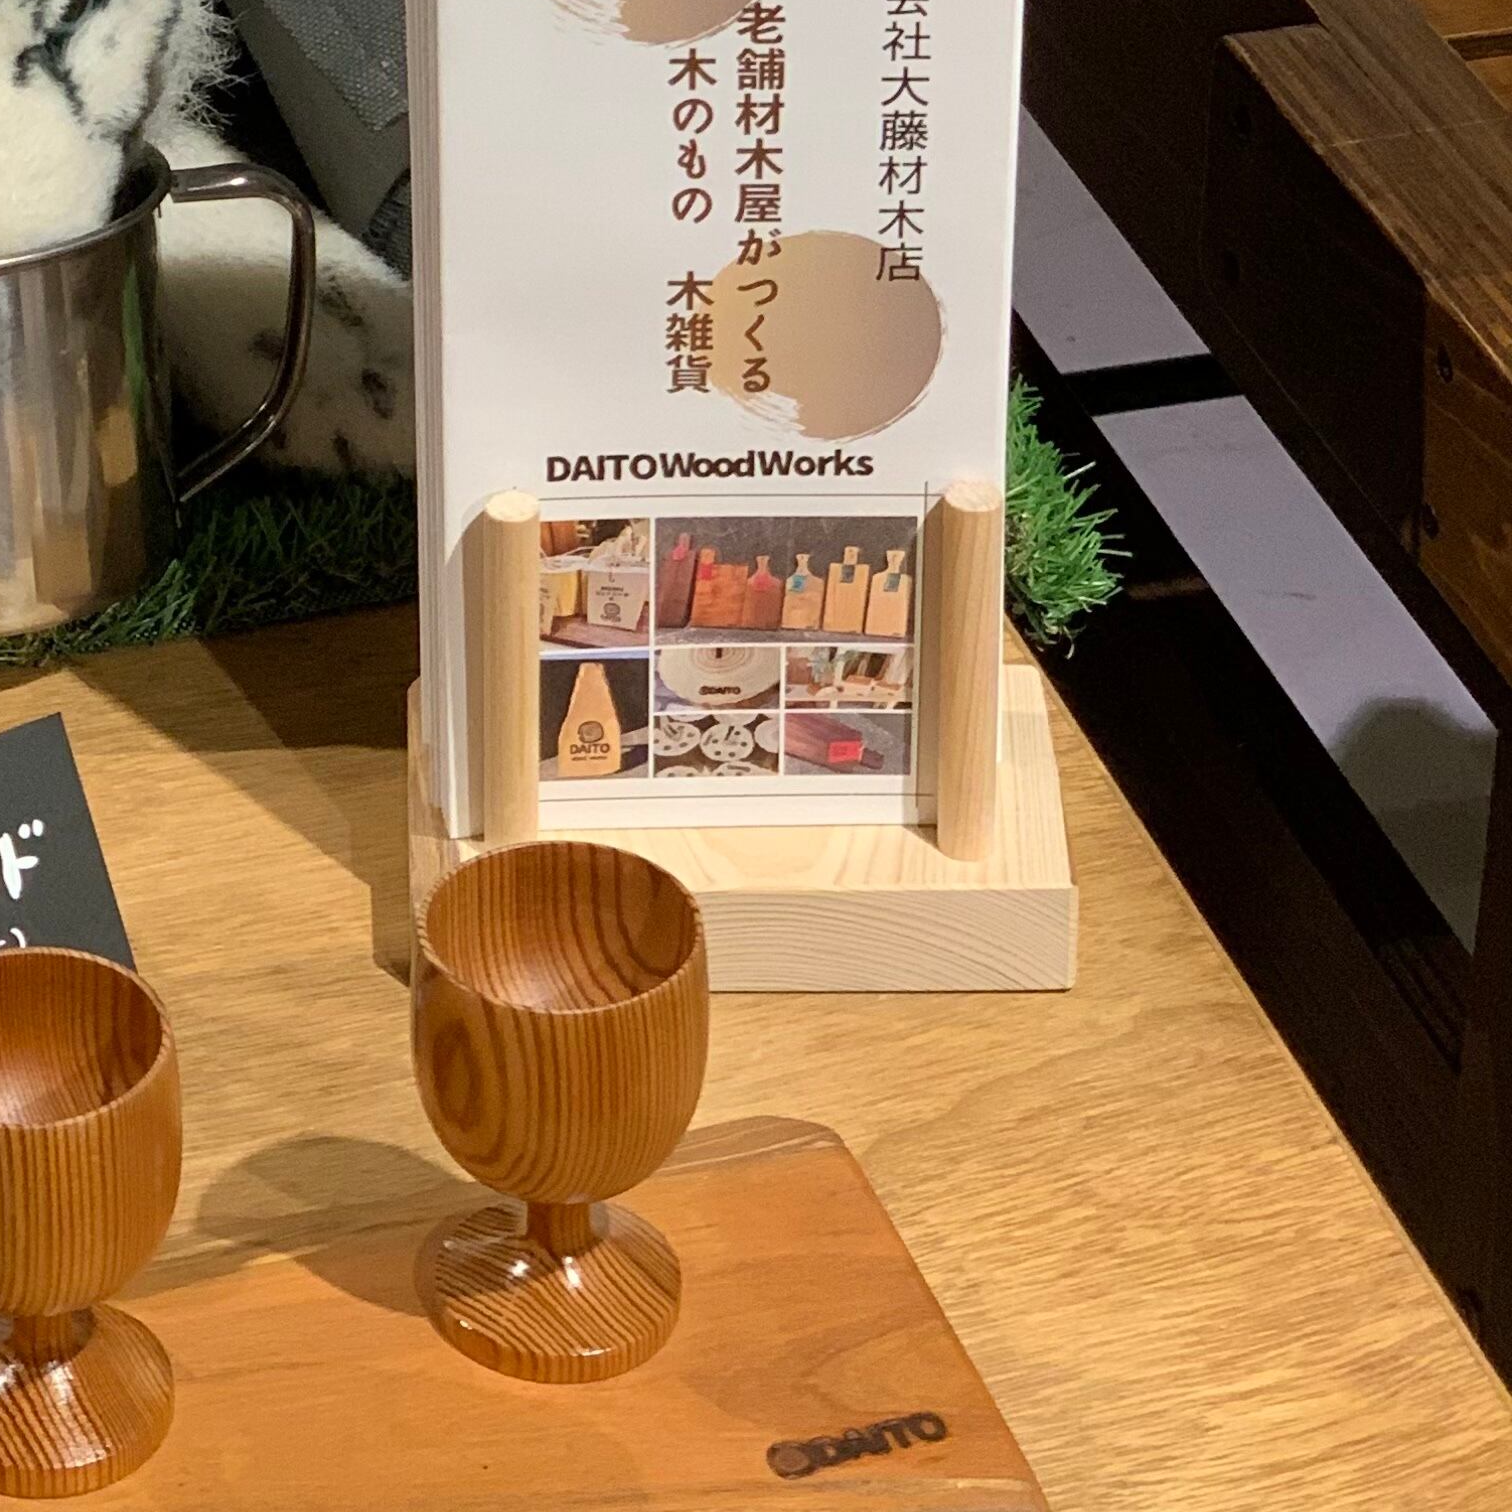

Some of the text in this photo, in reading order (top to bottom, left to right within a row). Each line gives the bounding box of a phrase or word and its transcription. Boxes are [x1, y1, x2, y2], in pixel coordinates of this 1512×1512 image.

[665, 48, 717, 394] 木のもの 木雑貨
[734, 1, 786, 393] 老舗材木屋がつくる
[570, 743, 610, 754] DAITO
[806, 1411, 949, 1466] DAITO
